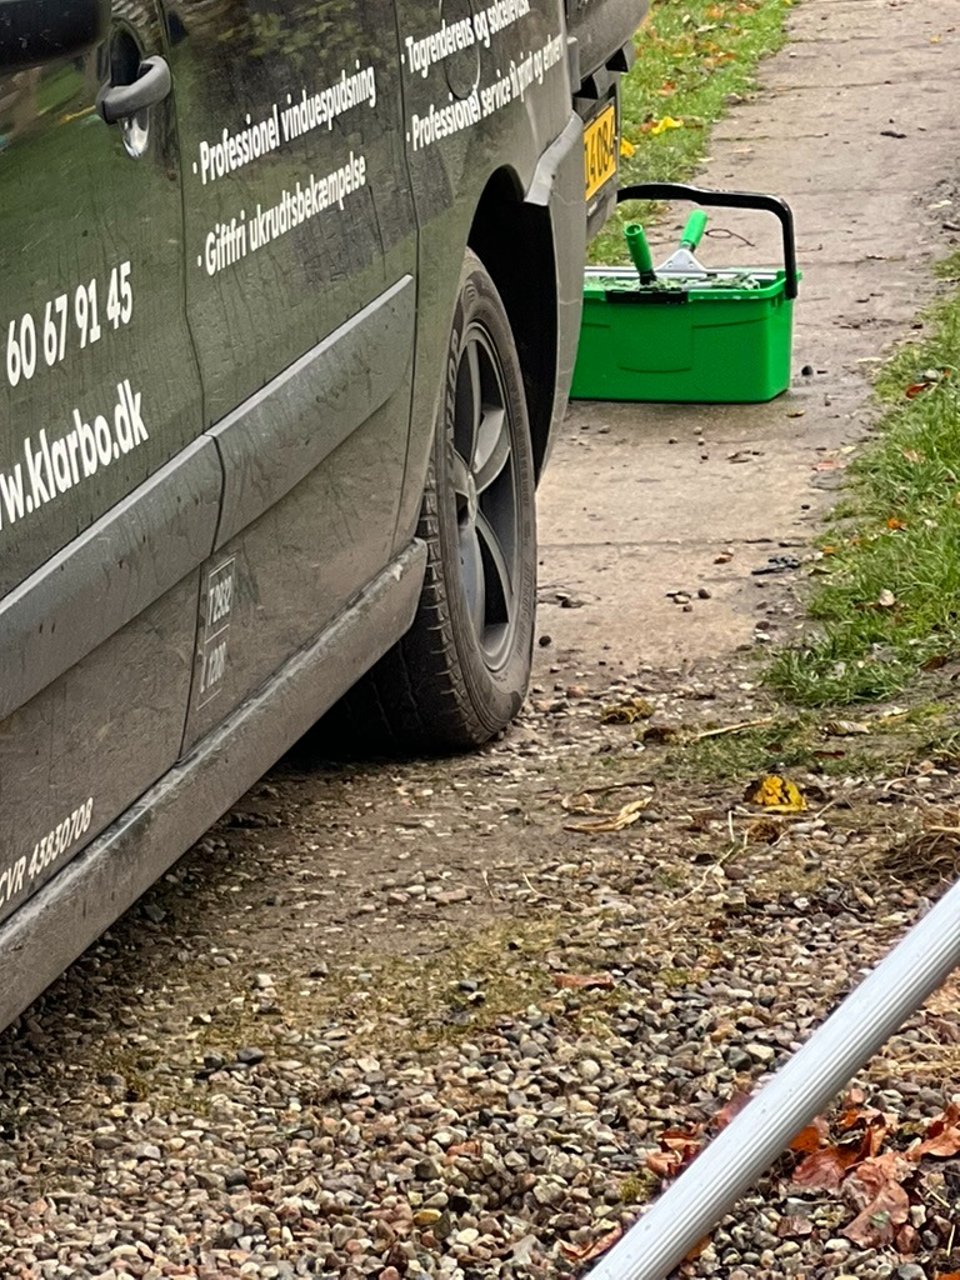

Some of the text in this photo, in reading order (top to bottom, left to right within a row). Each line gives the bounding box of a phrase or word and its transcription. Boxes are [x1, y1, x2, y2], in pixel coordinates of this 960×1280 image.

[405, 18, 475, 78] Tagrenderens
[473, 10, 491, 49] og
[200, 59, 376, 185] Professionel vinduespudsning
[412, 84, 481, 151] Professionel
[481, 69, 511, 118] service
[205, 151, 366, 276] Giftfri ukrudtsbekæmpelse
[6, 313, 36, 387] 60
[43, 294, 68, 366] 67
[75, 278, 101, 349] 91
[106, 260, 133, 330] 45
[28, 797, 94, 880] 43830708
